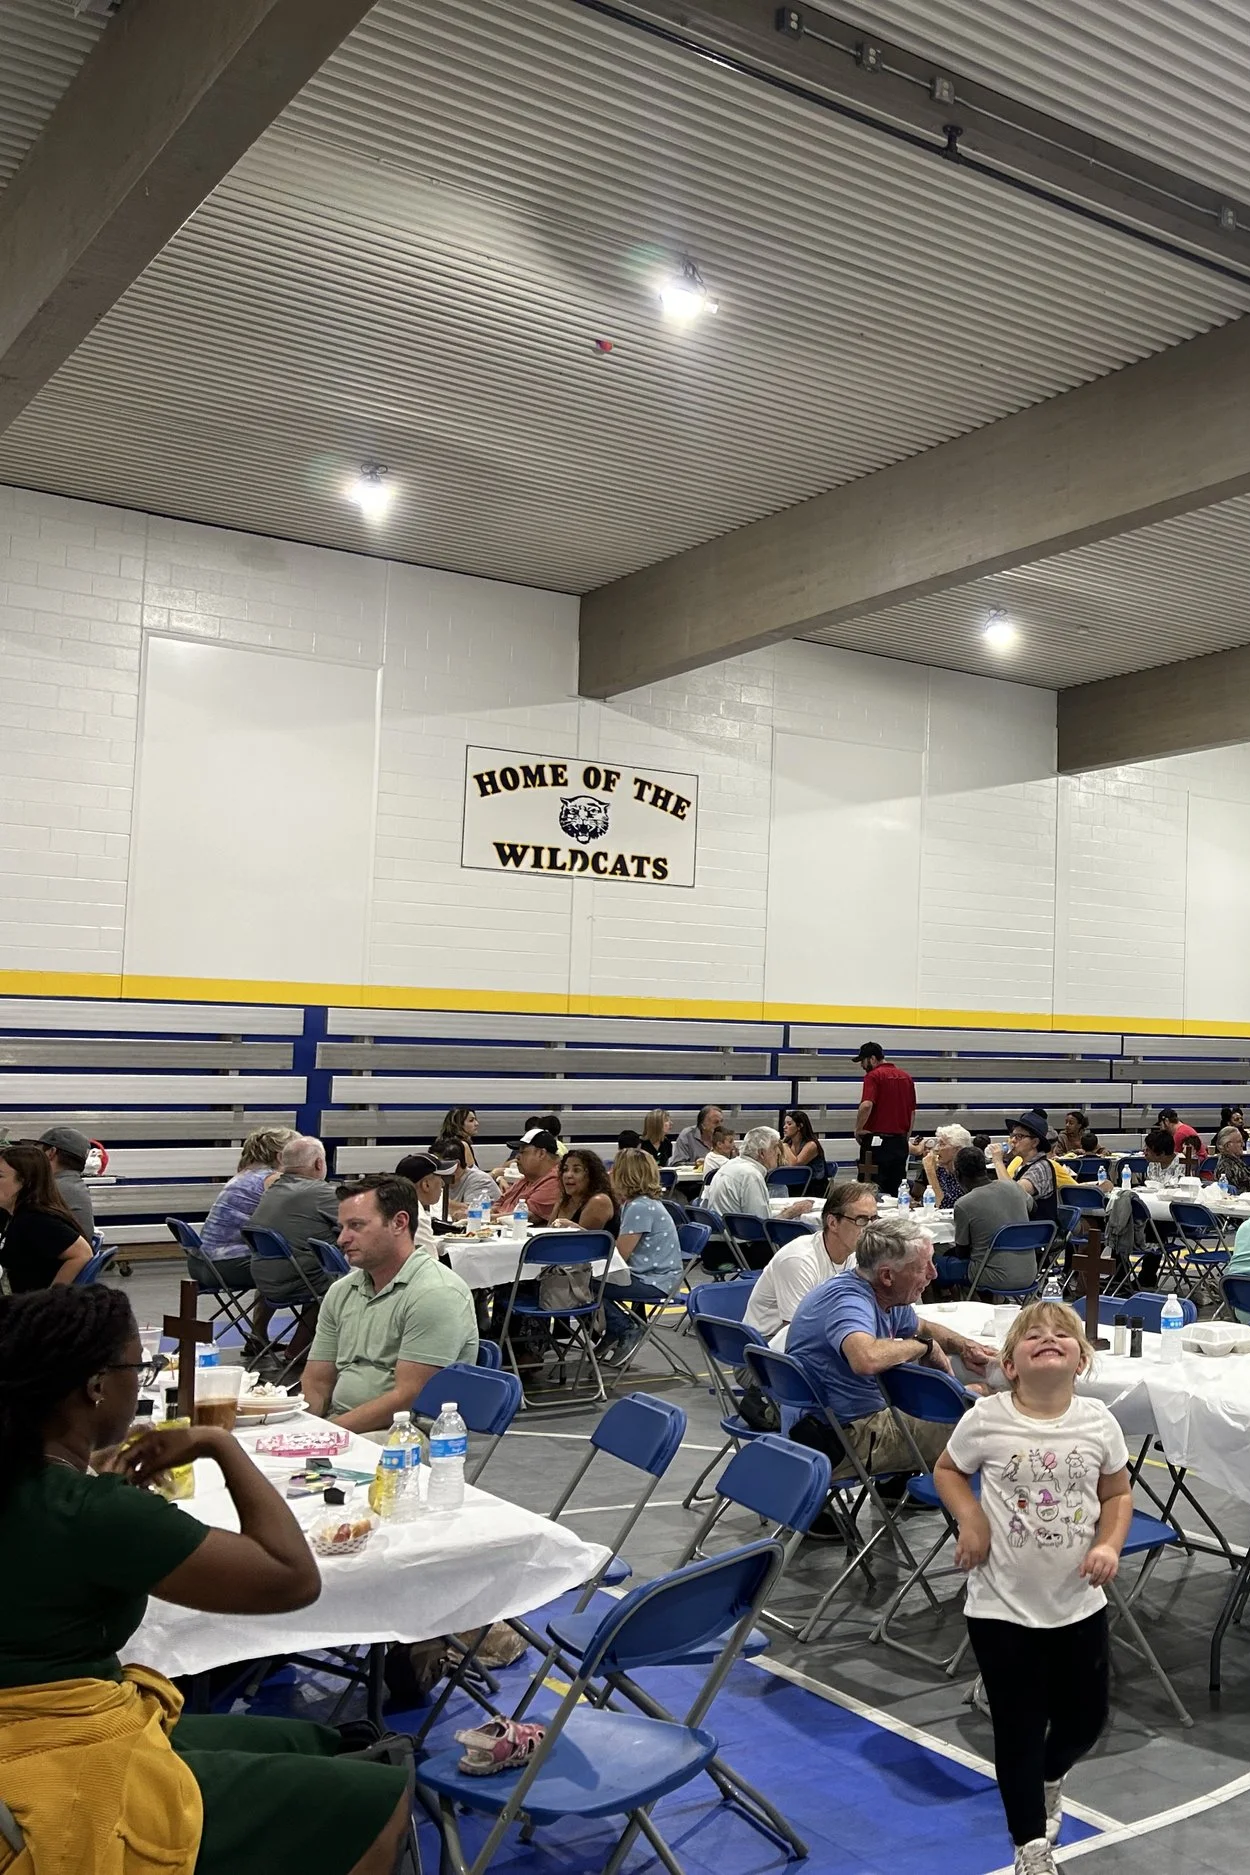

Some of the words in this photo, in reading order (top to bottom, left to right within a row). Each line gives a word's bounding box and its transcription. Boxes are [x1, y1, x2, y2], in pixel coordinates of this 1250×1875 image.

[473, 764, 568, 797] HOME
[582, 766, 621, 792] OF
[633, 777, 691, 820] THE
[493, 842, 669, 880] WILDCATS
